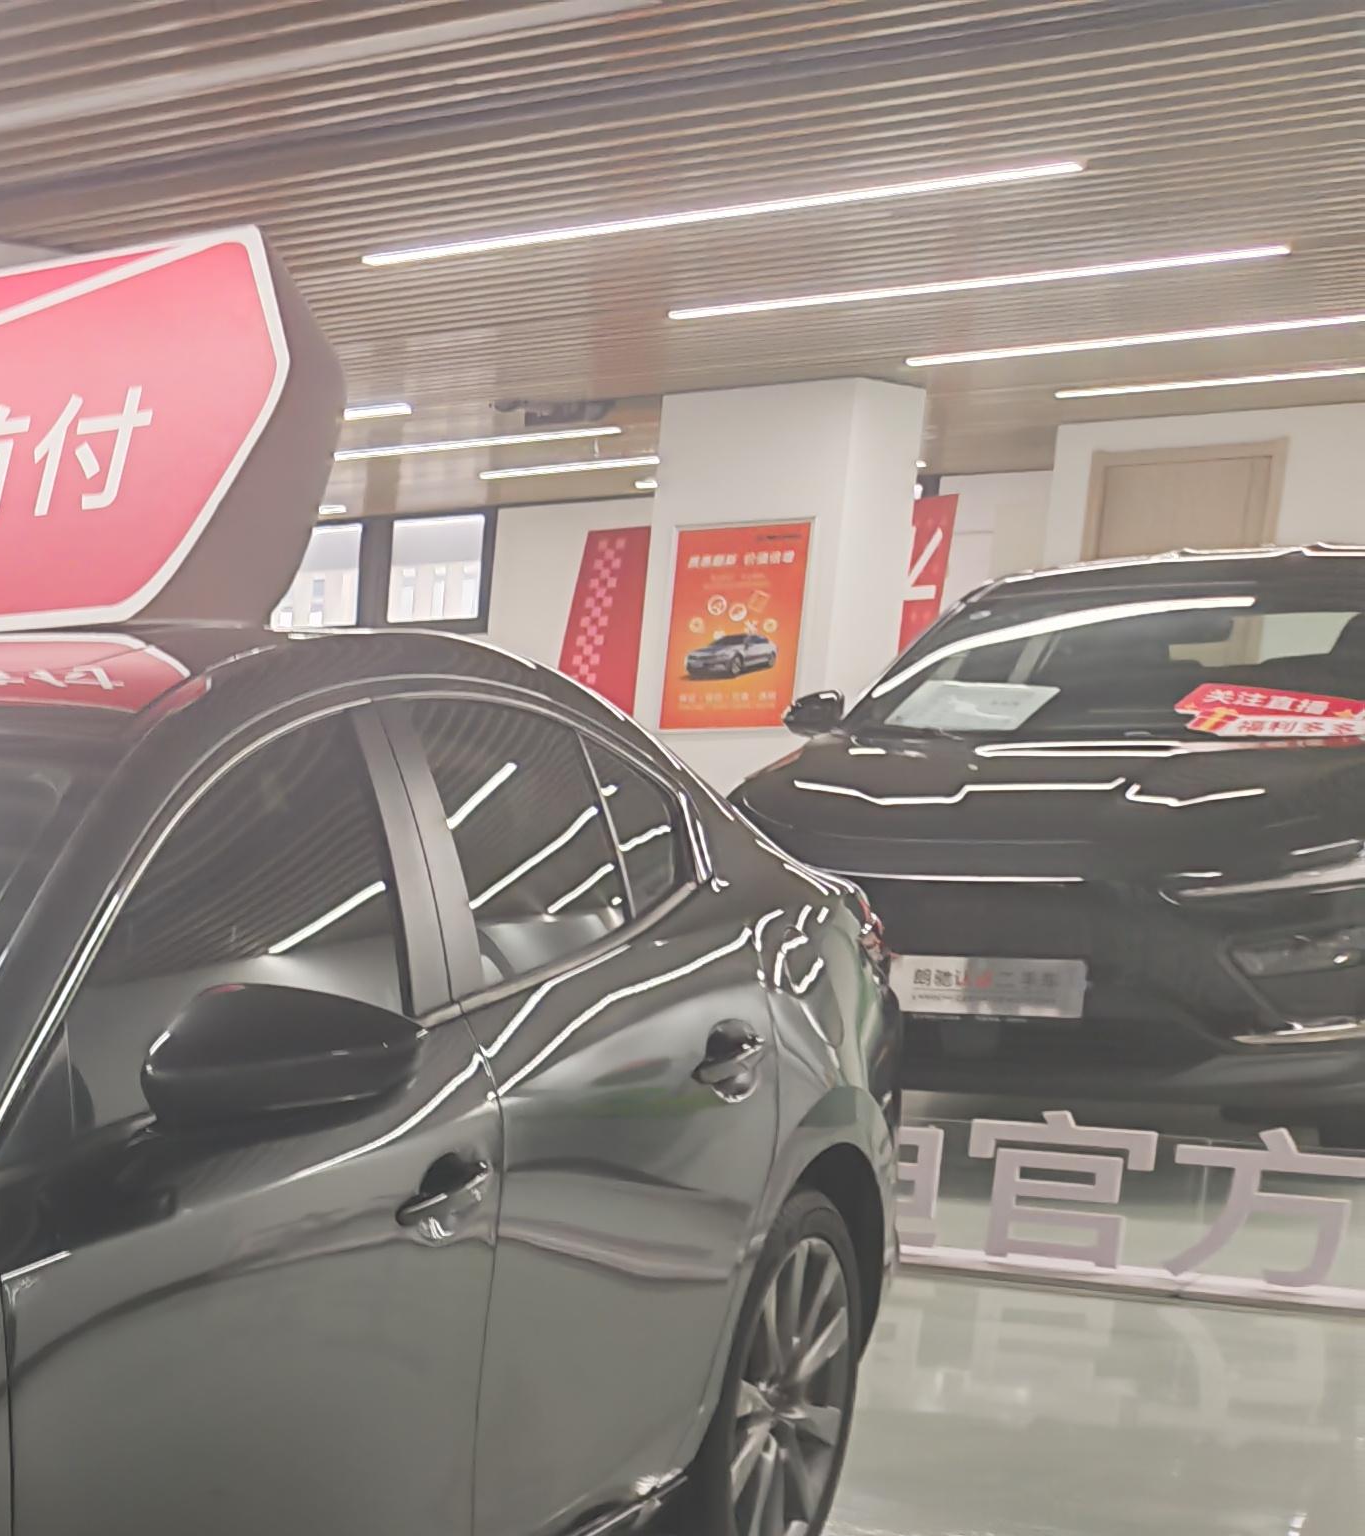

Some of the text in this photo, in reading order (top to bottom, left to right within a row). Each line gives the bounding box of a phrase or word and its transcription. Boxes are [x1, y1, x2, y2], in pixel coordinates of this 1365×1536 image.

[1202, 688, 1331, 716] 关注直播
[1236, 719, 1356, 737] 福利多多
